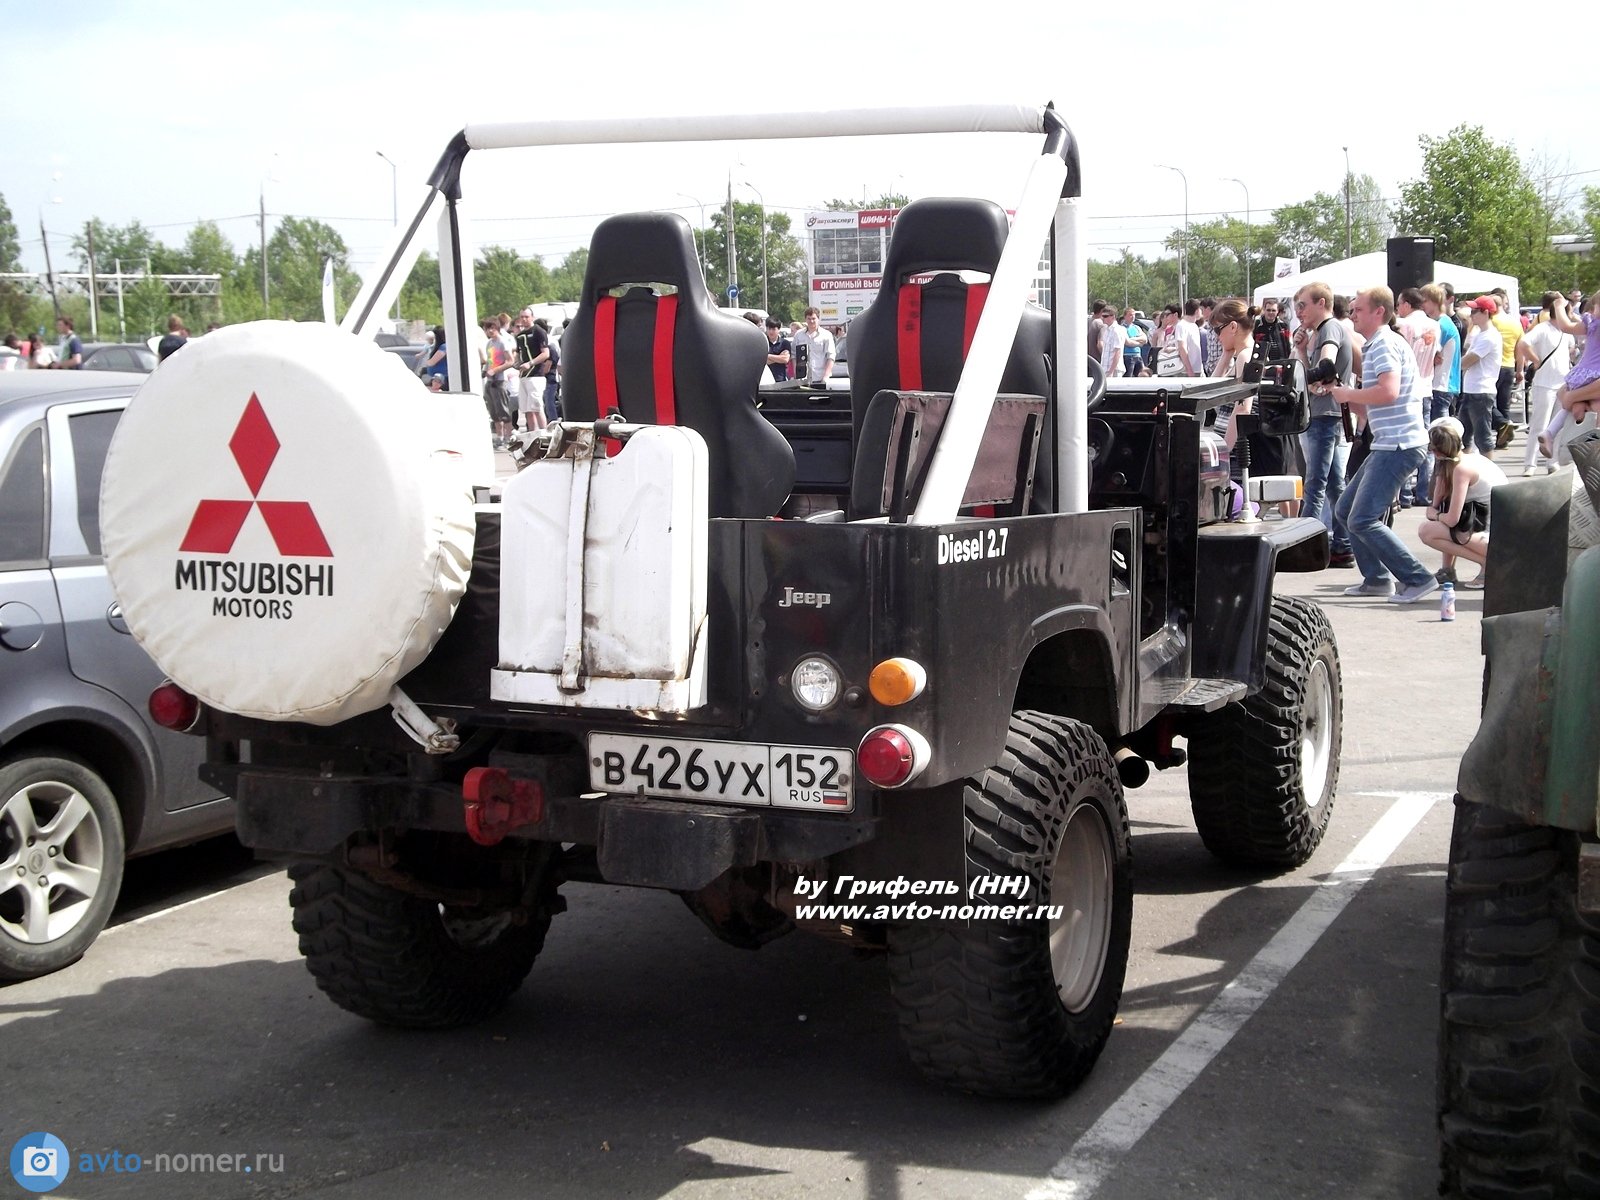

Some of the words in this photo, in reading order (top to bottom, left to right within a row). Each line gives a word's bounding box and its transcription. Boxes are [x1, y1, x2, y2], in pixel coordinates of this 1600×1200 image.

[820, 279, 862, 290] ОГРОМНЫЙ
[937, 529, 984, 565] Diesel
[987, 527, 1009, 558] 2.7
[175, 559, 334, 597] MITSUBISHI
[212, 597, 293, 620] MOTORS
[778, 586, 831, 608] Jeep
[775, 753, 840, 791] 152
[789, 789, 822, 803] RUS
